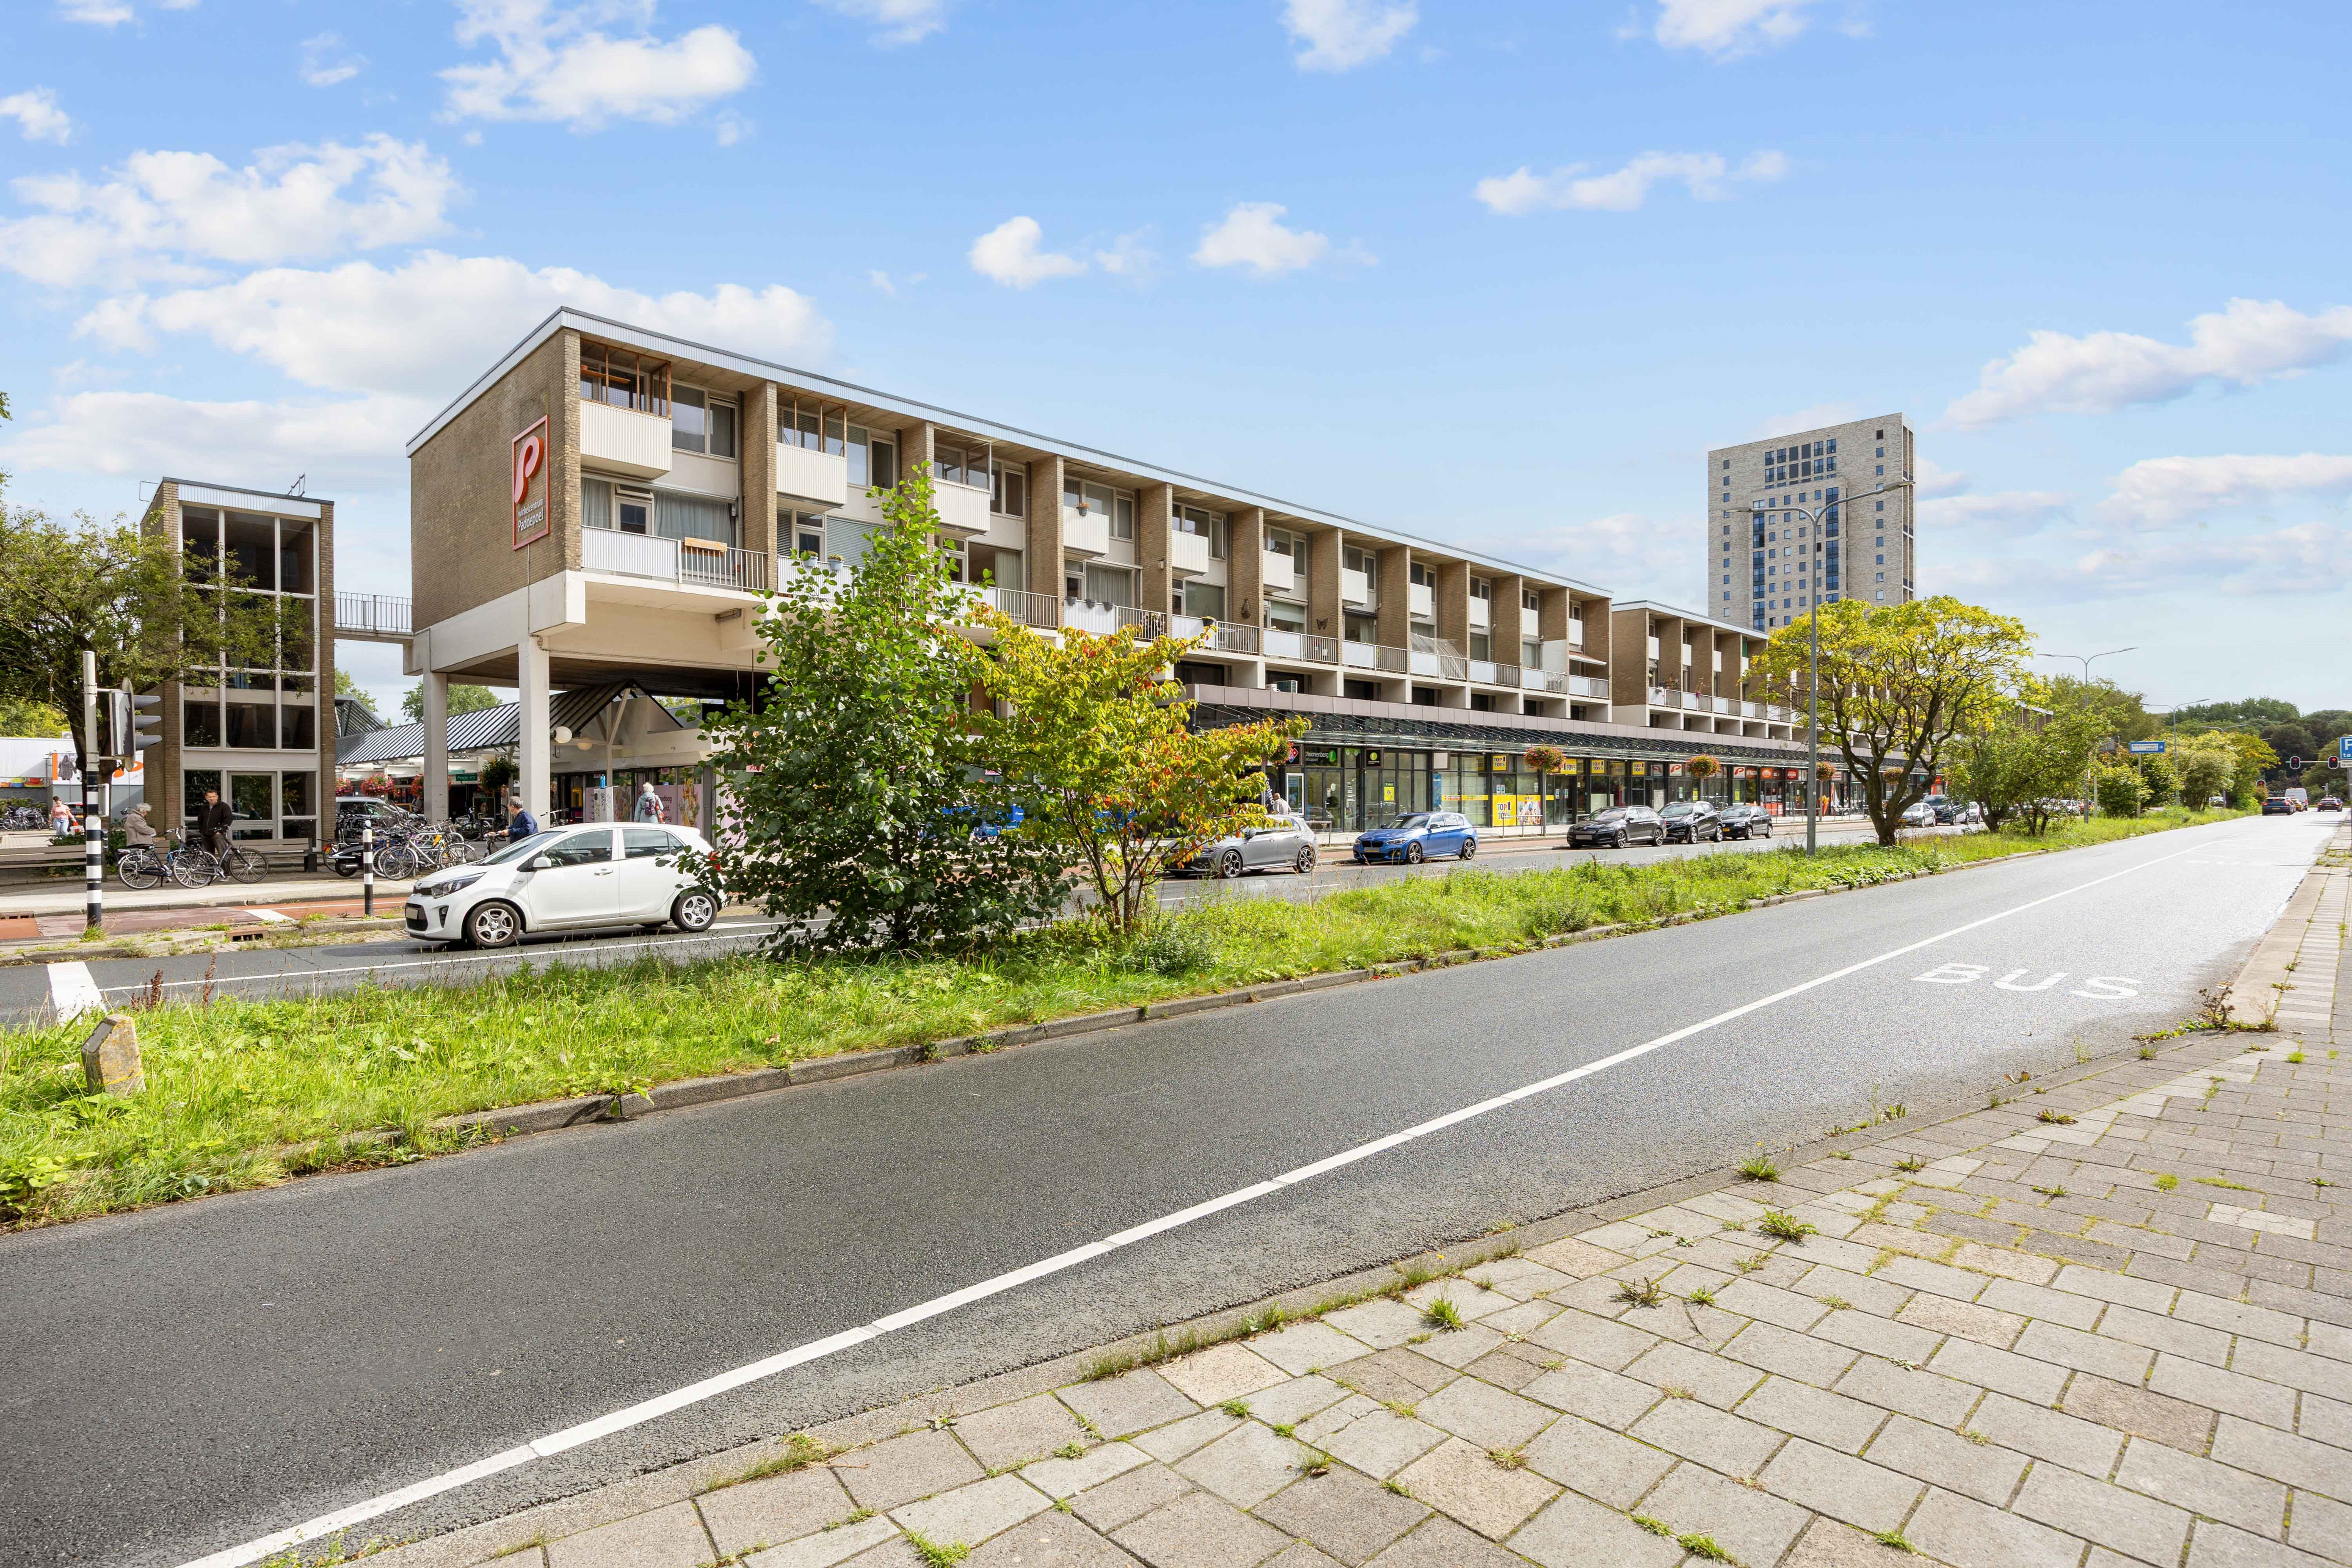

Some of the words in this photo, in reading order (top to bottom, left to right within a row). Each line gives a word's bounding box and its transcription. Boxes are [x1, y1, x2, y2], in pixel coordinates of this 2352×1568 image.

[518, 497, 544, 517] winkelcentrum
[517, 511, 544, 532] Paddepoel
[2345, 739, 2352, 750] P
[1498, 812, 1511, 820] TOYS
[1911, 962, 2142, 999] BUS
